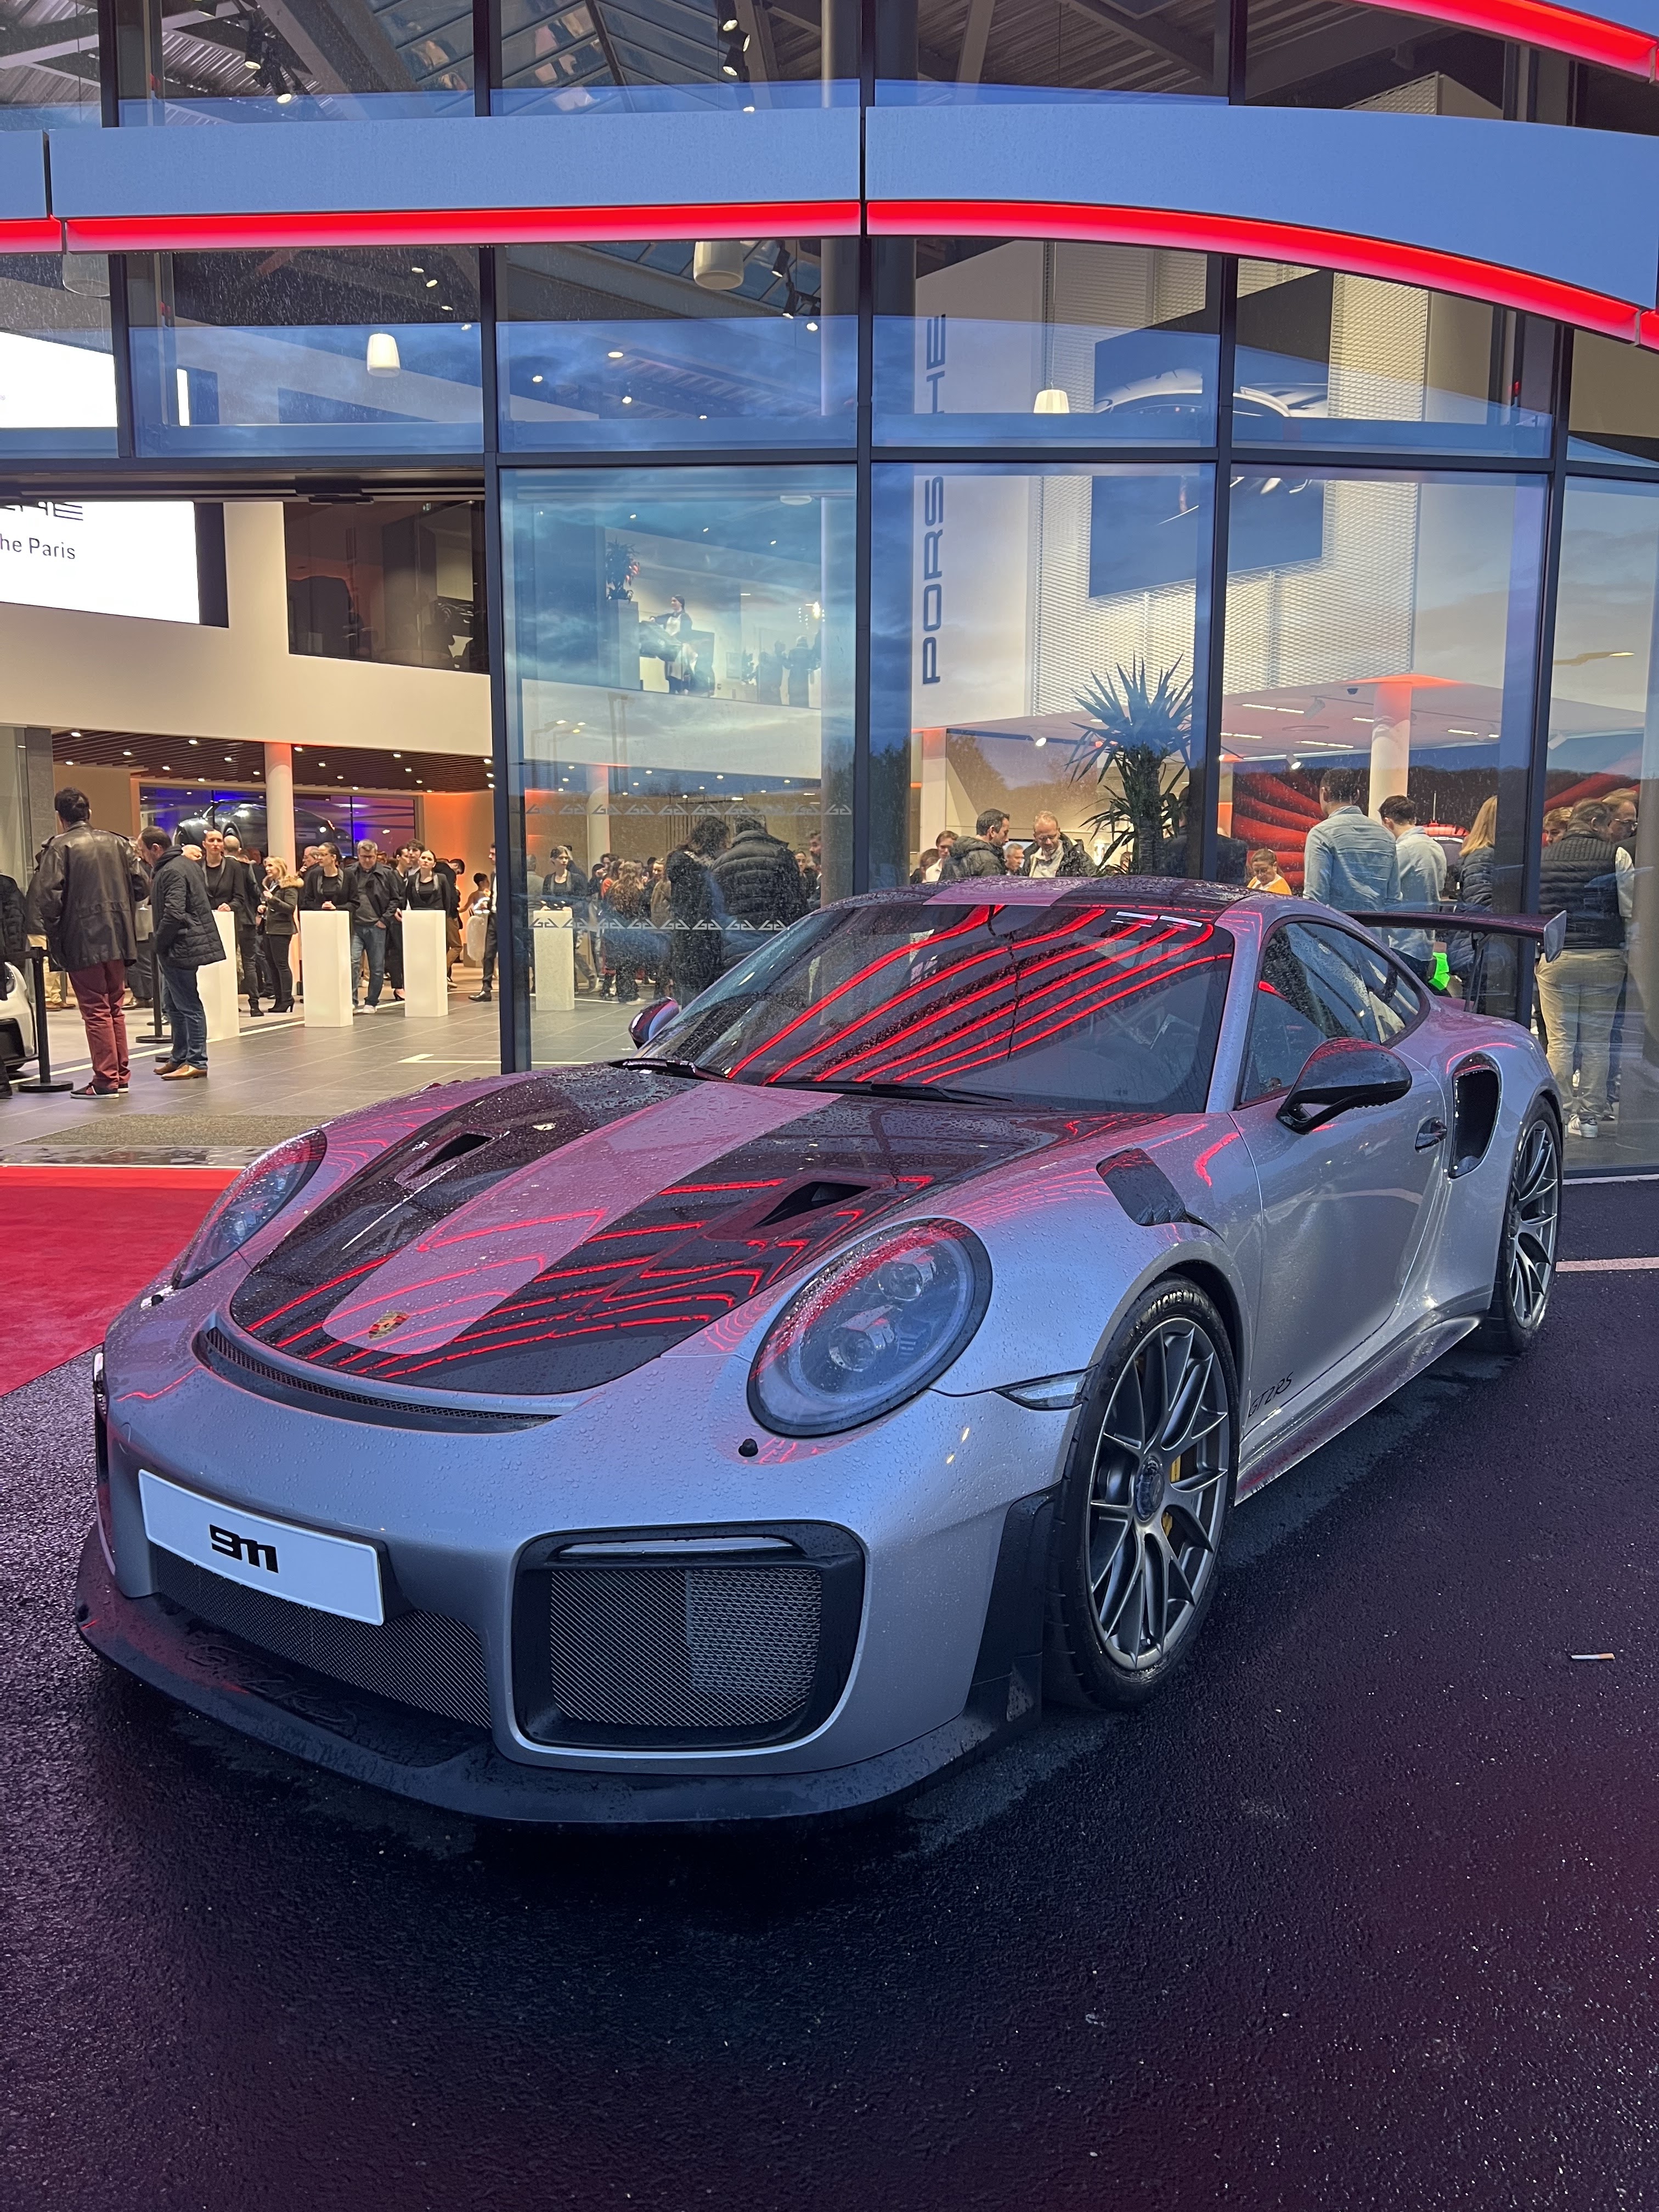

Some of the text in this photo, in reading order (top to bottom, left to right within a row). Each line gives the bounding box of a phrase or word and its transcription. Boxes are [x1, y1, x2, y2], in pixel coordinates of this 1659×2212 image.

[923, 314, 946, 685] PORSHE
[29, 537, 75, 560] Paris
[210, 1524, 279, 1573] 911
